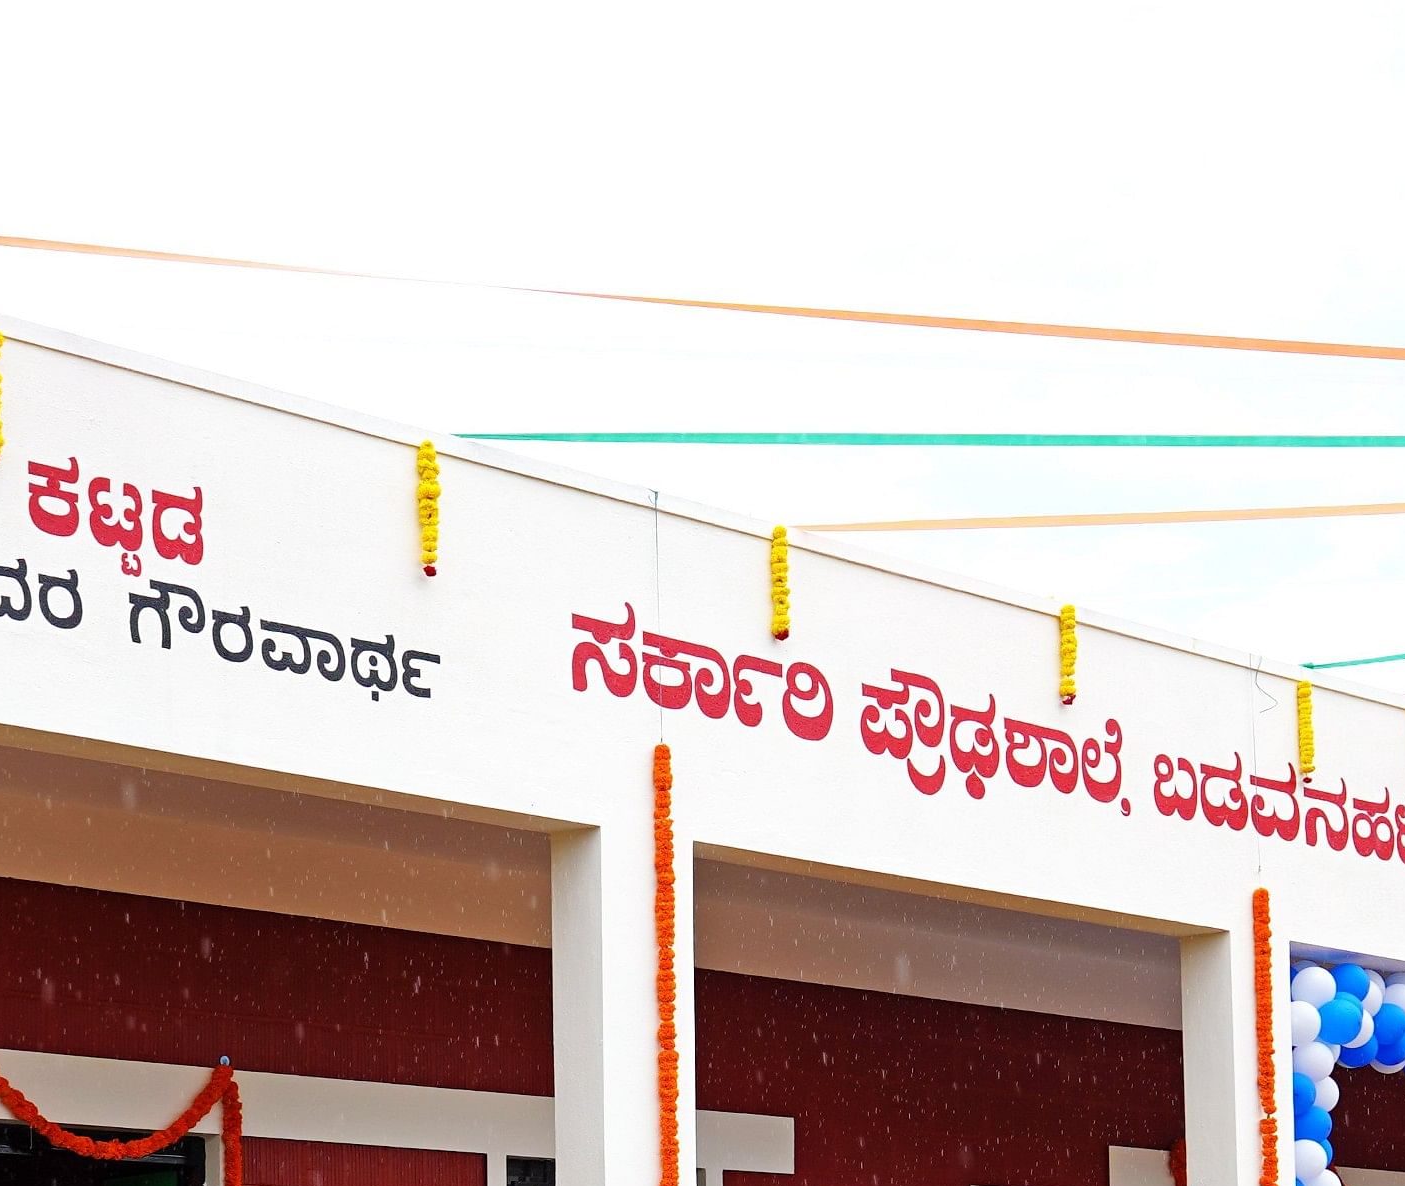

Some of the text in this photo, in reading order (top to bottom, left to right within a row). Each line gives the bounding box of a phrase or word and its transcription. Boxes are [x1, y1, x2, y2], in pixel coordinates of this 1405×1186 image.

[28, 456, 204, 576] ಕಟ್ಟಡ
[128, 579, 441, 701] ಗೌರವಾರ್ಥ
[571, 602, 834, 741] ಸರ್ಕಾರಿ
[860, 668, 1132, 817] ಪ್ರೌಢಶಾಲೆ,
